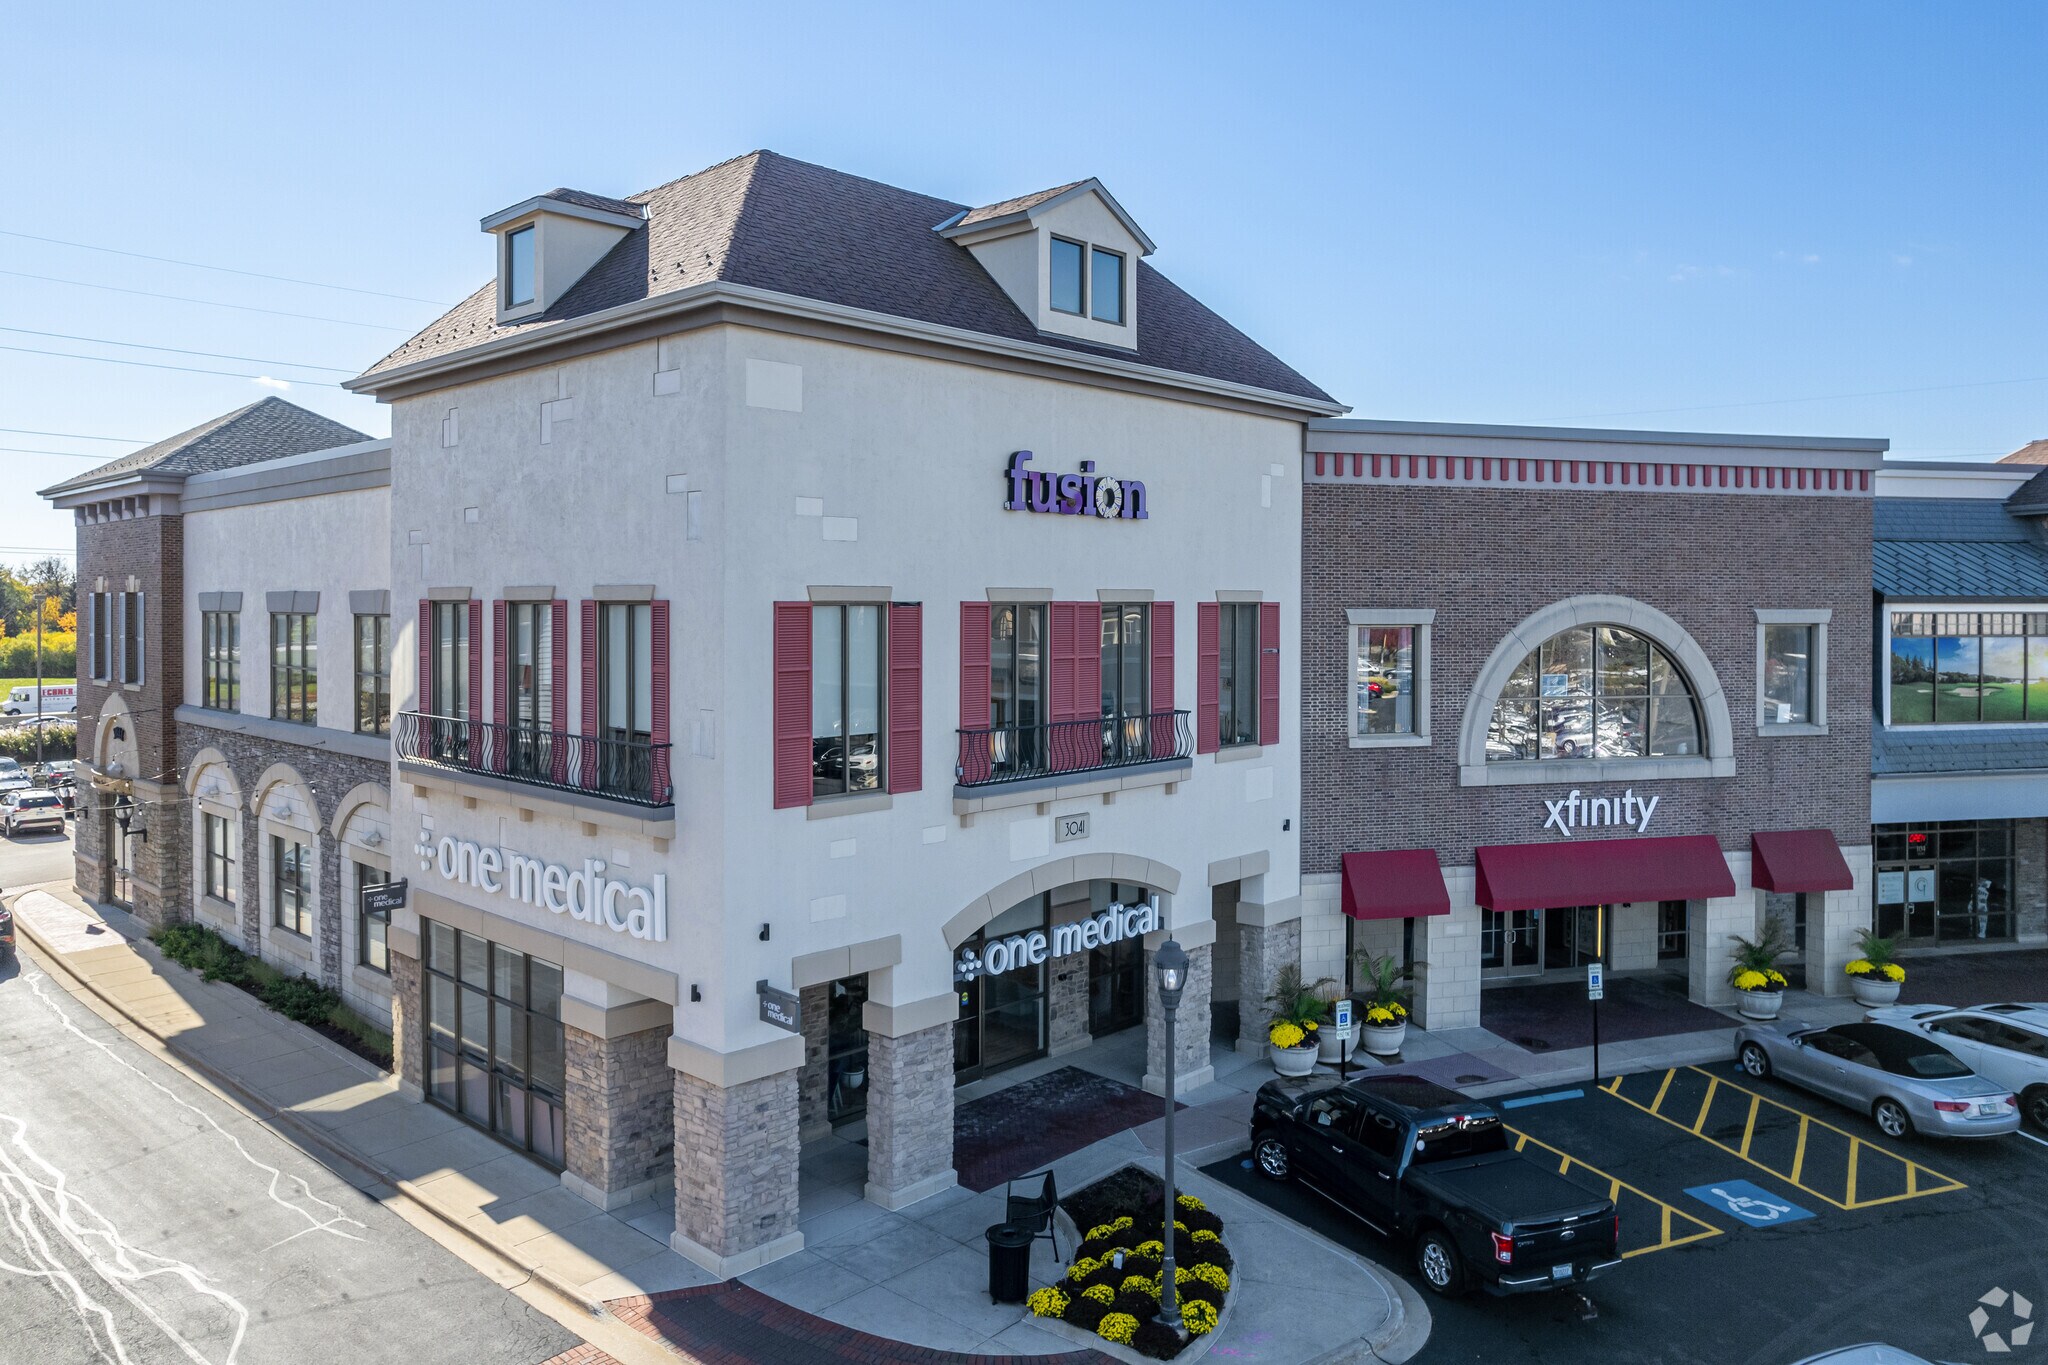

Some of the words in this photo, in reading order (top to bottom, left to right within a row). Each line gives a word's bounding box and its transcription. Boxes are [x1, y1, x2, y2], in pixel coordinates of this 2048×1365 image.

[1005, 450, 1148, 519] fusion
[42, 688, 73, 696] ECHNER
[1543, 788, 1660, 836] xfinity
[1065, 820, 1085, 837] 3041
[438, 836, 503, 893] one
[509, 857, 667, 942] medical
[373, 894, 388, 902] one
[373, 896, 403, 908] medical
[984, 931, 1047, 976] one
[1052, 893, 1159, 958] medical
[767, 1002, 781, 1013] one
[767, 1010, 793, 1026] medical
